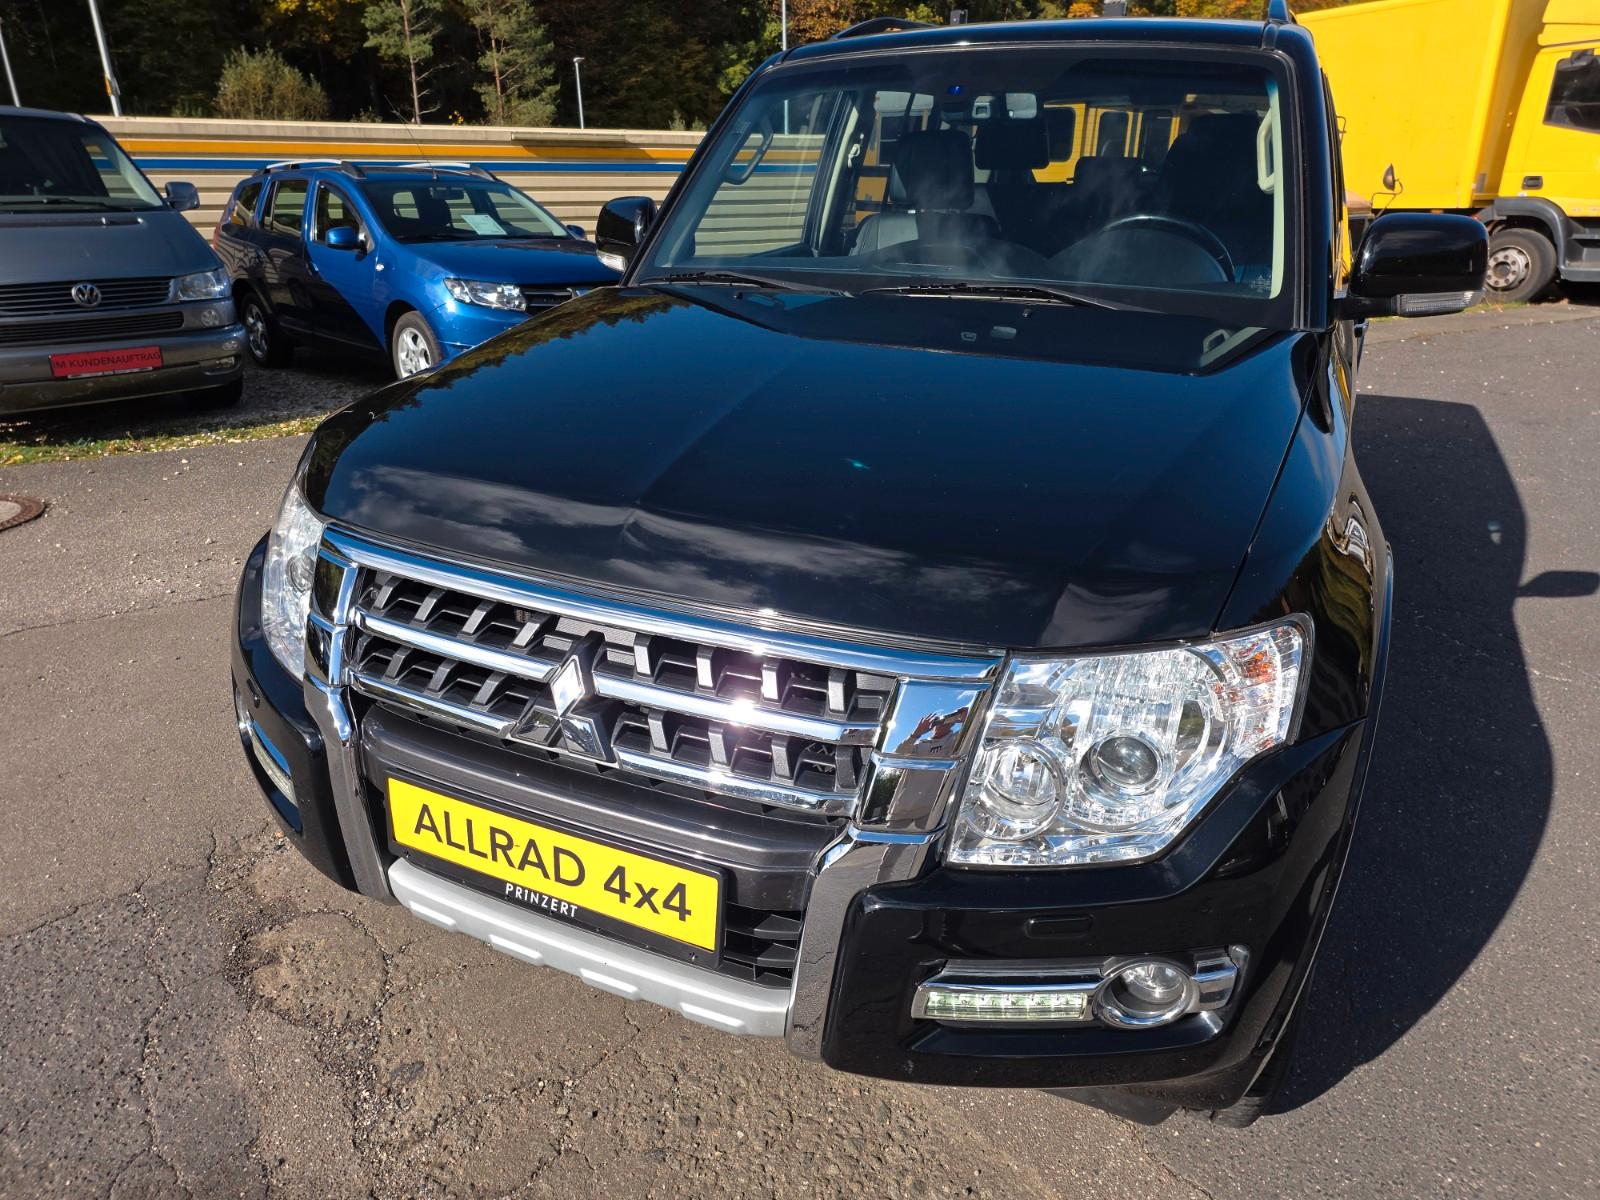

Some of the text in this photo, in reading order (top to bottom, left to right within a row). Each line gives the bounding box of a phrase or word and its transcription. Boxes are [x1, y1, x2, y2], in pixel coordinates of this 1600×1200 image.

[53, 351, 160, 369] IM KUNDENAUFTRAG
[413, 803, 692, 923] ALLRAD 4x4
[505, 883, 579, 918] PRINZERT
